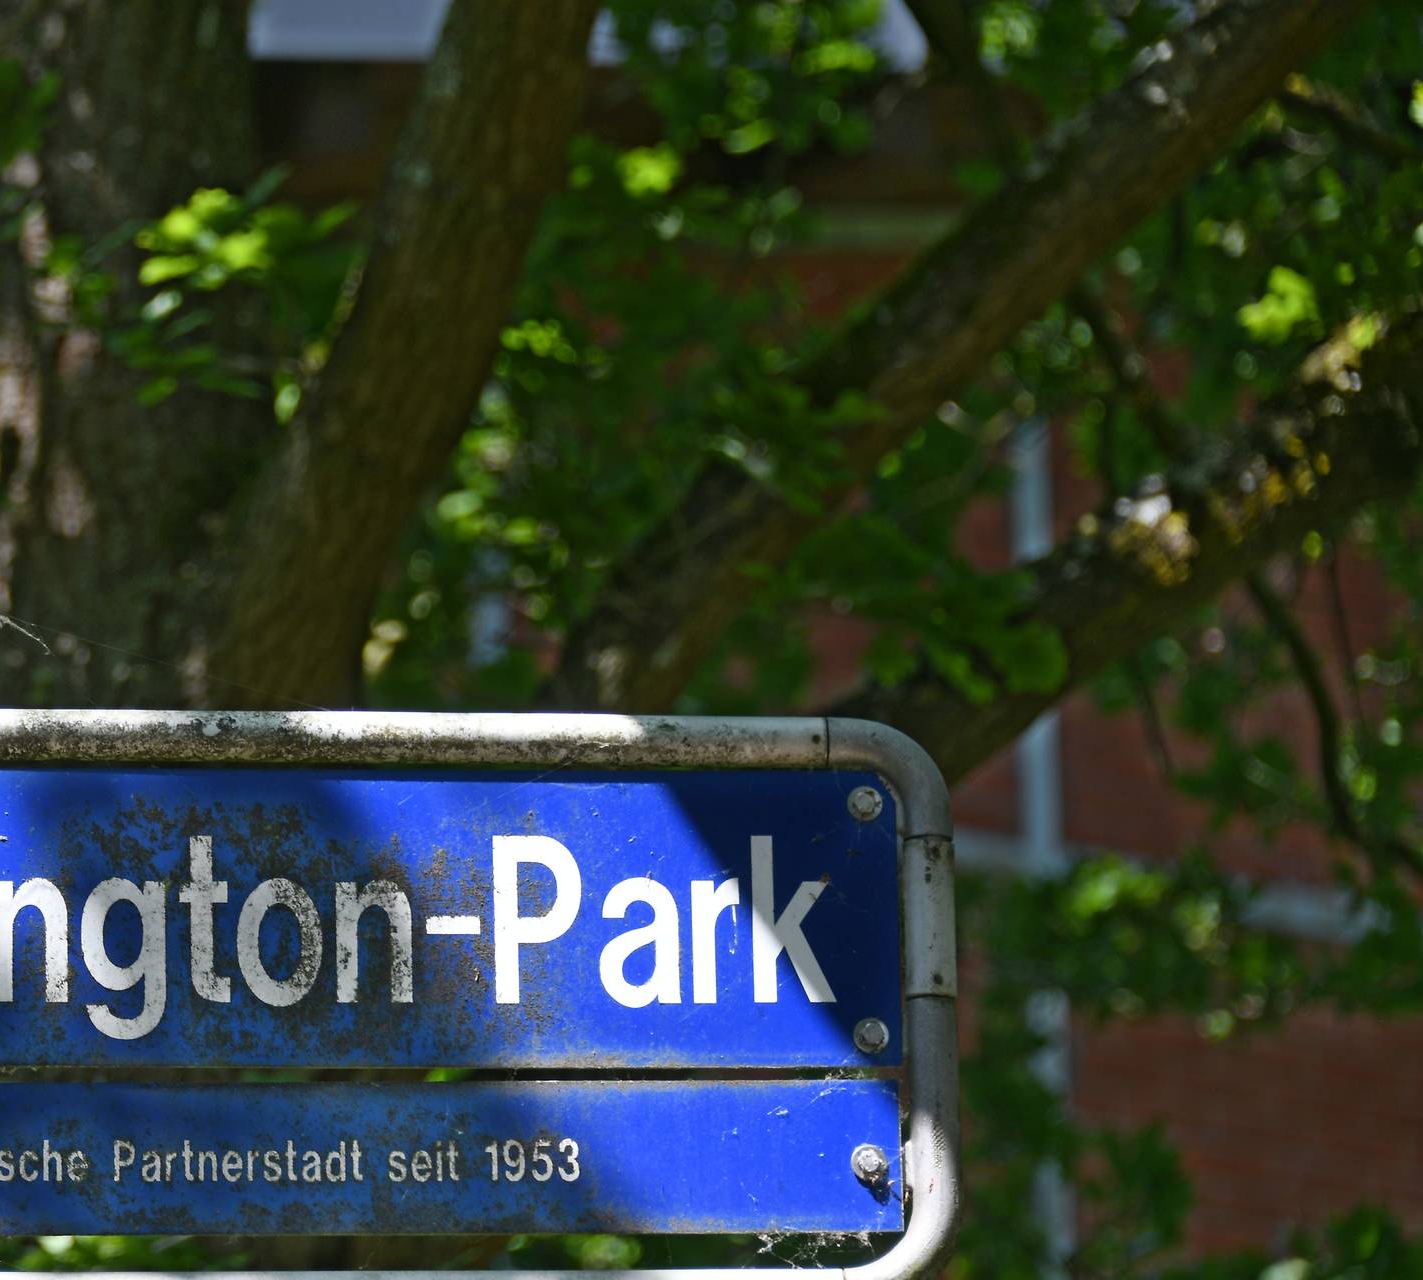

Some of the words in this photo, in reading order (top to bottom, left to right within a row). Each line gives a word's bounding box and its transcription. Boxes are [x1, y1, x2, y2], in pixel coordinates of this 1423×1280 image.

[113, 1138, 365, 1183] Partnerstadt
[388, 1138, 460, 1182] seit
[484, 1138, 581, 1183] 1953
